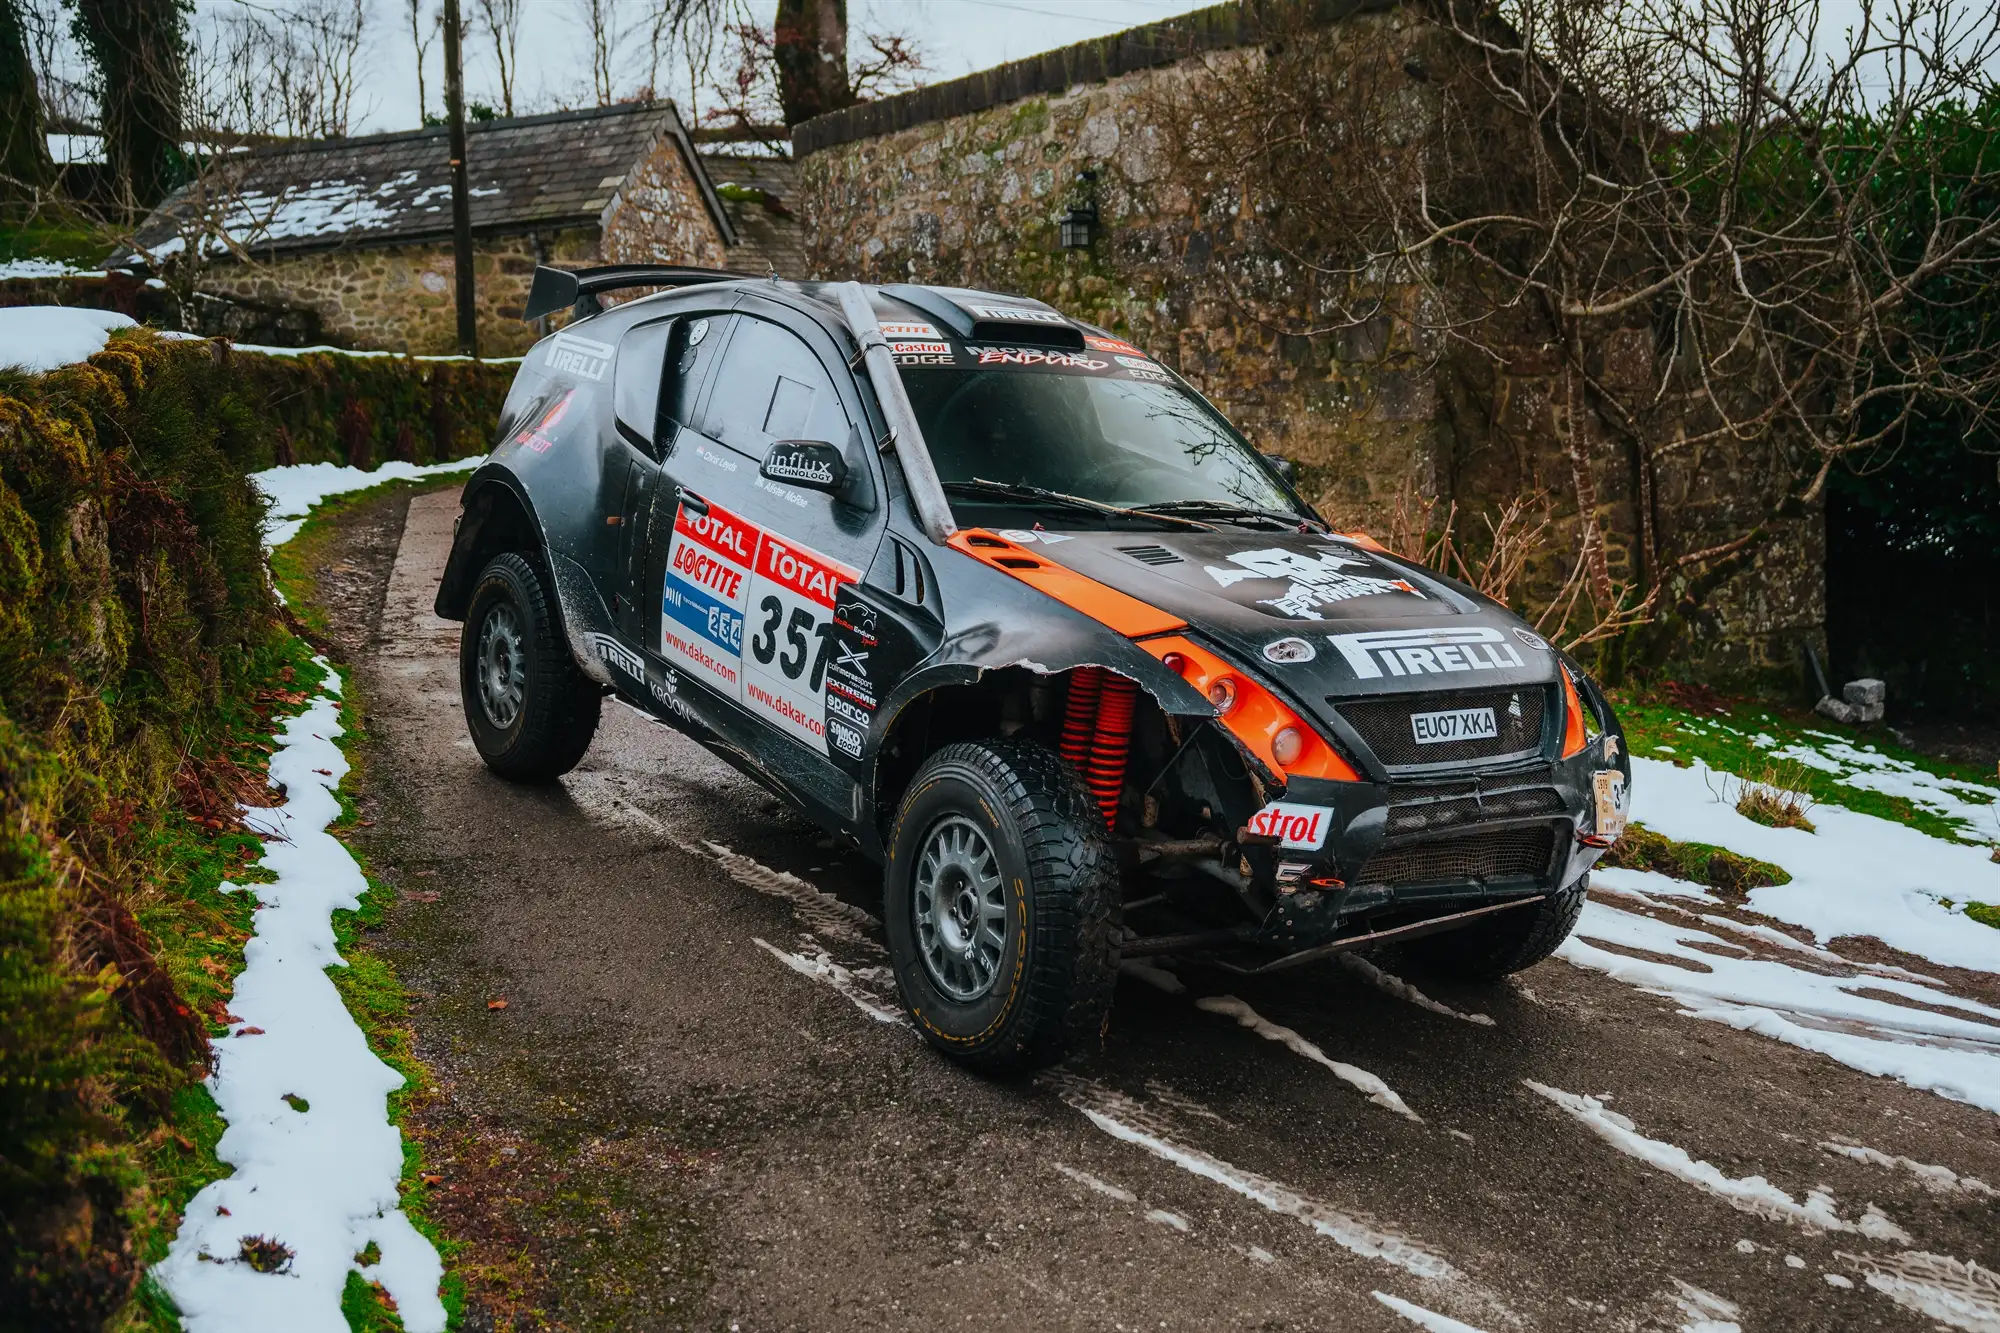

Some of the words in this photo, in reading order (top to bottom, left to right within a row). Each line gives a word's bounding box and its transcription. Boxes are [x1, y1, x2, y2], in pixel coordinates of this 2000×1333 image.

[967, 305, 1067, 324] PIRELLI
[880, 326, 930, 334] OCTITE
[545, 332, 615, 381] PIRELLI
[894, 343, 948, 353] Castrol
[703, 451, 720, 465] Chris
[770, 451, 831, 474] influx
[768, 466, 833, 483] TECHNOLOGY
[673, 543, 742, 599] LOCTITE
[583, 631, 646, 686] PIRELLI
[665, 631, 737, 684] www.dakar.com
[1327, 627, 1525, 679] PIRELLI
[650, 681, 691, 723] KROON
[826, 676, 877, 707] EXTREME
[827, 694, 870, 725] sparco
[830, 720, 861, 746] SAMCO
[1415, 715, 1457, 740] EU07
[1460, 712, 1495, 736] XKA
[837, 738, 861, 756] sport
[1248, 808, 1321, 843] strol
